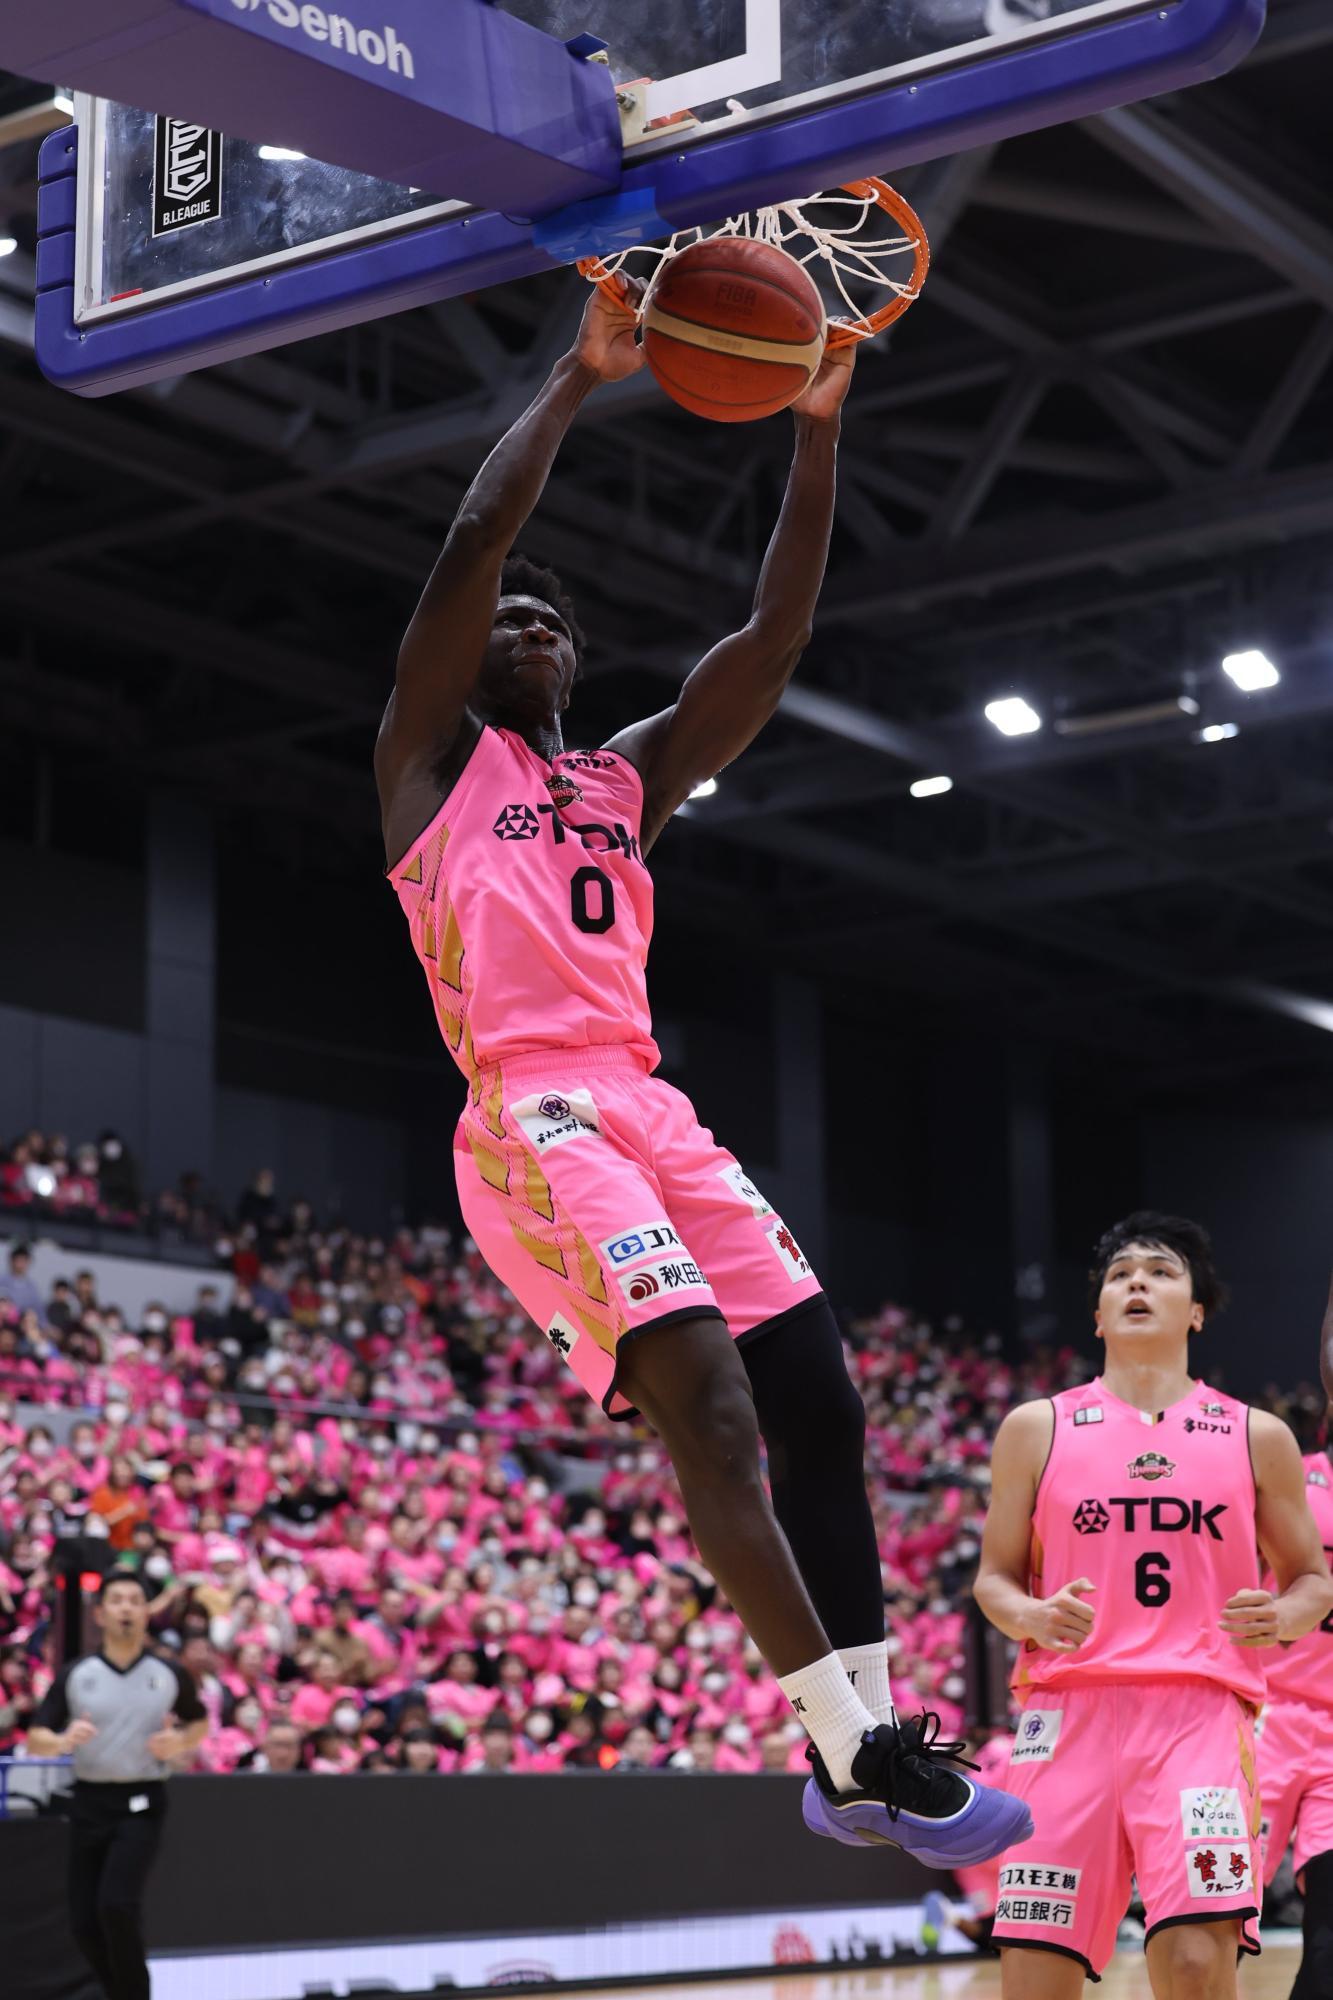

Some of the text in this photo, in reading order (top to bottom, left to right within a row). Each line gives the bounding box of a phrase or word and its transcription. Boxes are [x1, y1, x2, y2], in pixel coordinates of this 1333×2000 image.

[267, 0, 415, 80] Senoh
[162, 199, 211, 226] B.LEAGUE
[570, 866, 616, 935] 0
[1108, 1497, 1228, 1541] TDK
[1135, 1552, 1171, 1608] 6
[996, 1900, 1072, 1925] 秋田銀行
